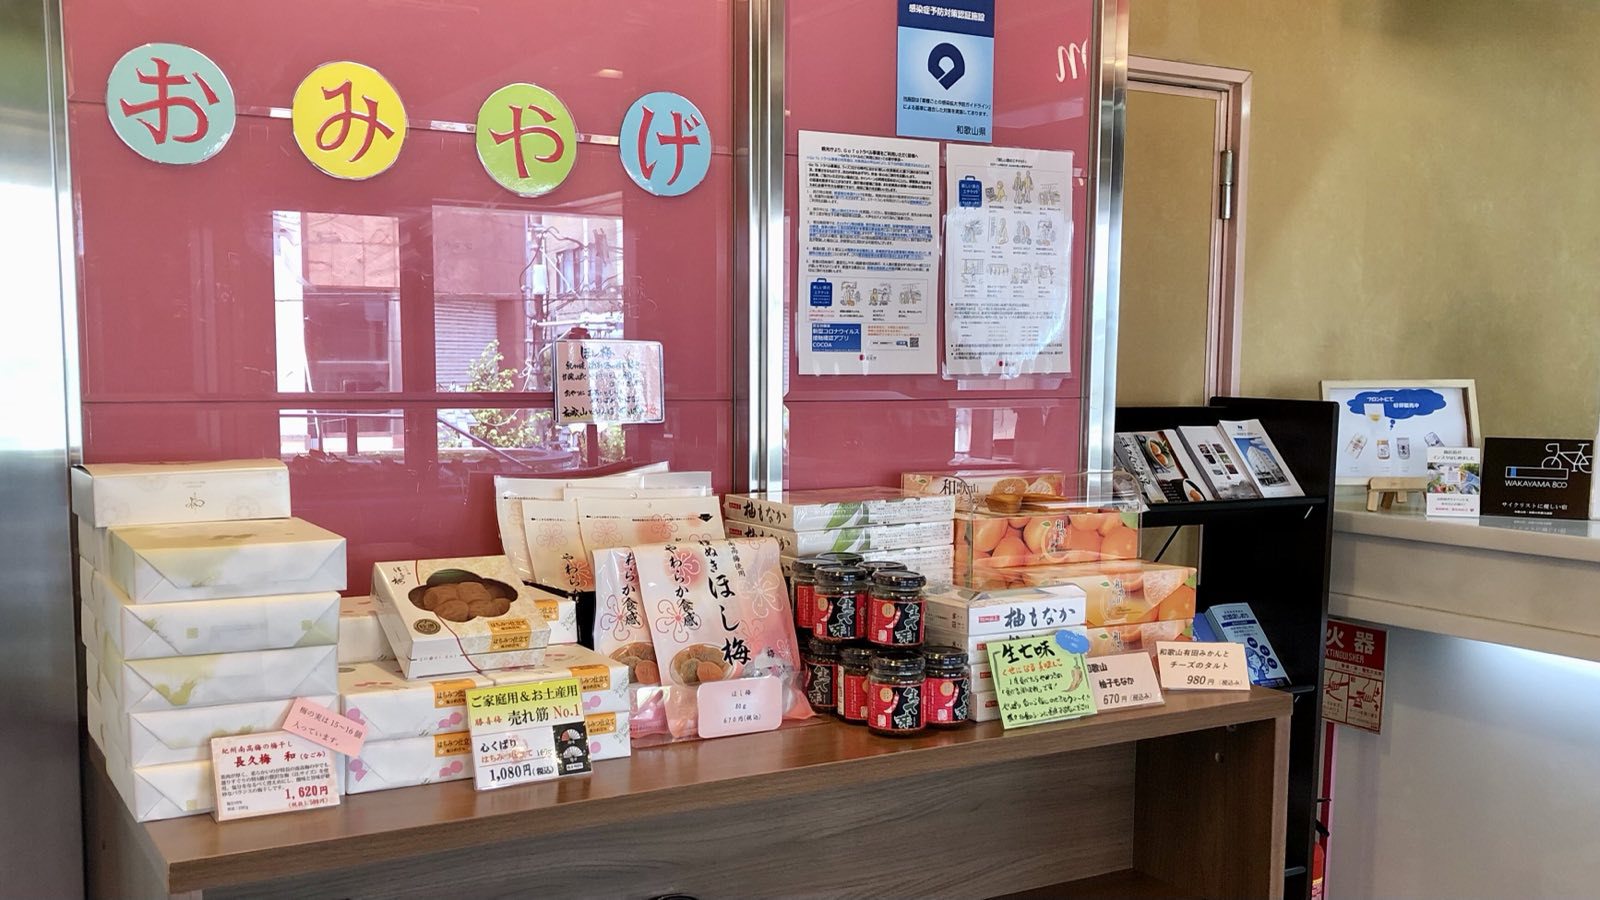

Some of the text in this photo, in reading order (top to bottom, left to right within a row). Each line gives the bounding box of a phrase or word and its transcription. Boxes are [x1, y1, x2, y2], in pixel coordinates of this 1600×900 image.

[956, 125, 986, 136] 和歌山県
[1505, 480, 1551, 488] WAKAYAMA
[743, 500, 787, 524] 柚もなか
[1003, 606, 1077, 629] 柚もなか
[1002, 640, 1056, 664] 生七味
[1159, 648, 1230, 658] 和歌山有田みかんと
[1170, 661, 1230, 671] チーズのタルト
[1099, 677, 1135, 689] 柚子もなか
[507, 705, 581, 727] 売れ筋 No.1
[221, 741, 294, 755] 紀州南高梅の梅干し
[481, 738, 517, 753] 心くばり
[234, 753, 272, 768] 長久梅
[284, 751, 296, 762] 和
